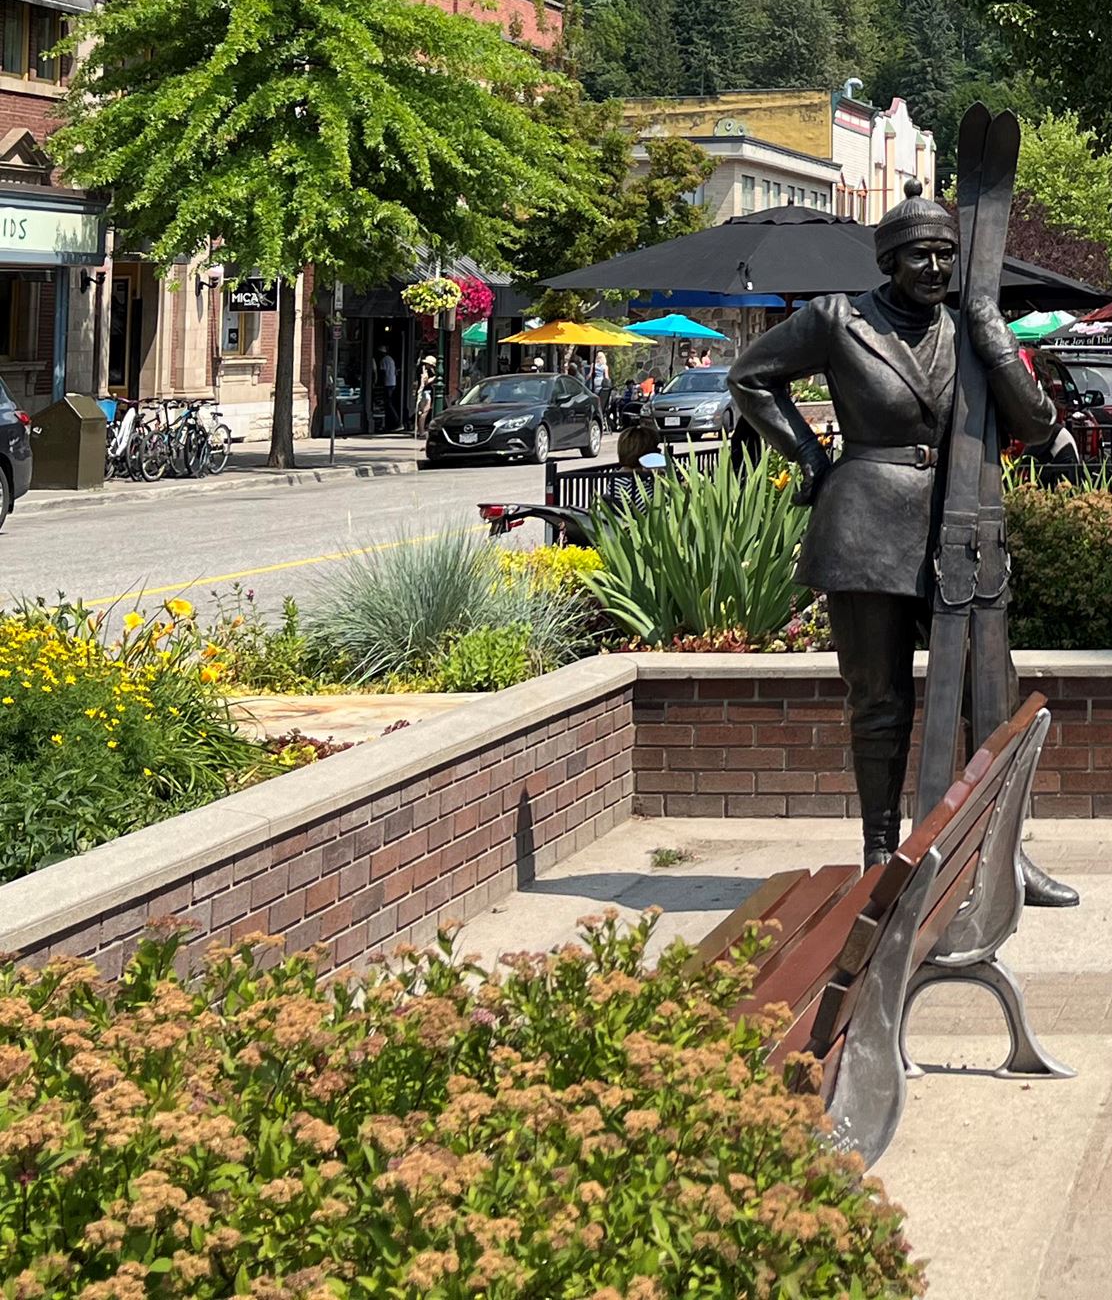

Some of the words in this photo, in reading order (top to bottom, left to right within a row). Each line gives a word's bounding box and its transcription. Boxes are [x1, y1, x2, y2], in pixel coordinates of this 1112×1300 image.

[232, 292, 258, 303] MICA
[1054, 337, 1069, 346] The
[1072, 337, 1085, 346] Joy
[1086, 336, 1094, 345] of
